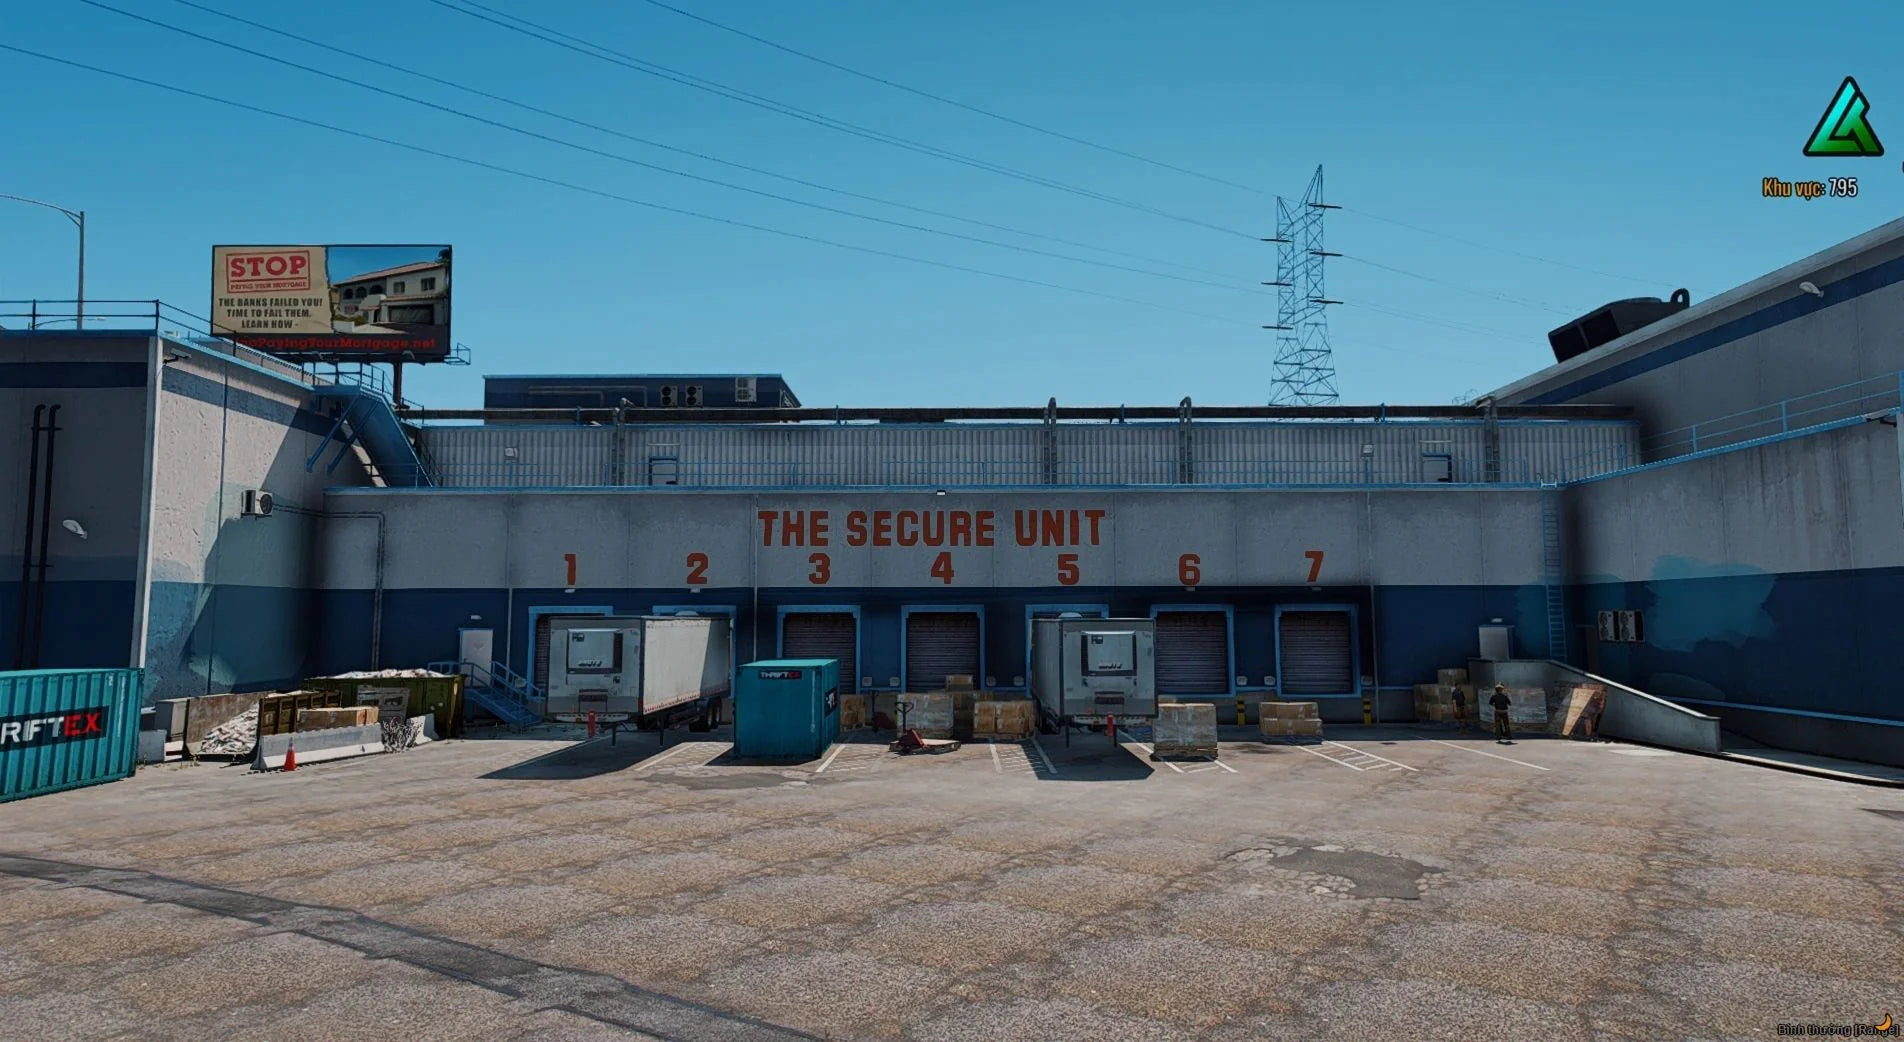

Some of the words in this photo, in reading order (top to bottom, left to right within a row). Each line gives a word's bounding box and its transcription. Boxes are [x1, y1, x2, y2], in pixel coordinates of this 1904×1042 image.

[230, 255, 306, 277] STOP
[219, 298, 235, 307] THE
[237, 298, 267, 307] BANKS
[270, 298, 299, 307] FAILED
[302, 298, 322, 307] YOU!
[227, 309, 248, 317] TIME
[251, 309, 262, 317] TO
[264, 309, 282, 317] FAIL
[285, 309, 312, 317] THEM.
[242, 320, 269, 328] LEARN
[758, 511, 829, 546] THE
[847, 511, 994, 546] SECURE
[1014, 510, 1105, 546] UNIT
[564, 554, 576, 585] 1
[686, 553, 708, 584] 2
[809, 553, 830, 584] 3
[930, 552, 954, 584] 4
[1057, 554, 1080, 585] 5
[1178, 554, 1201, 585] 6
[1304, 551, 1324, 582] 7
